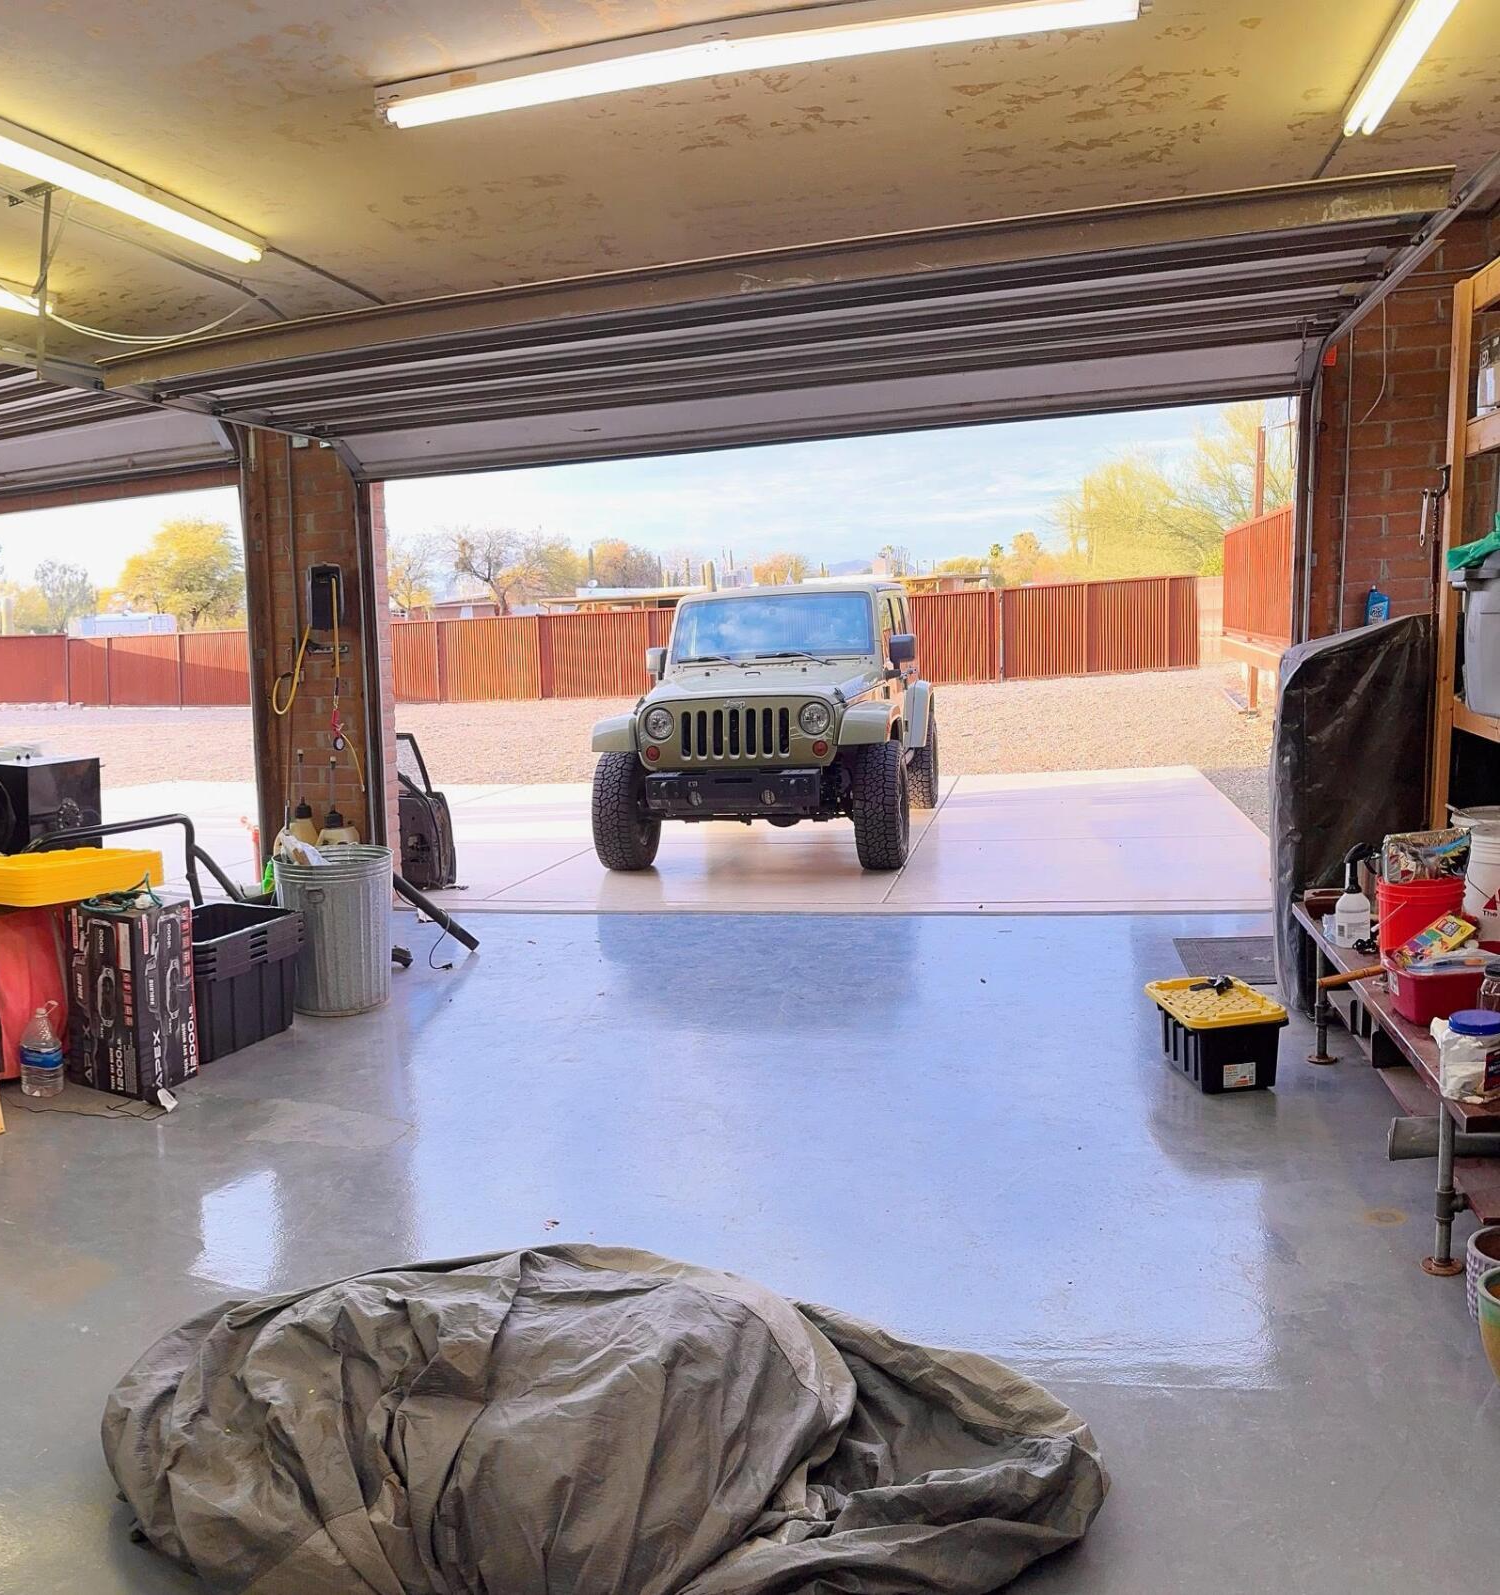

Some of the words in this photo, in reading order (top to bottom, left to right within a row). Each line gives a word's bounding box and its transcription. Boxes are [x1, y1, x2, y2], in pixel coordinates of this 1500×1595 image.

[723, 700, 746, 710] Jeep
[82, 1024, 93, 1083] APEX
[152, 1029, 164, 1088] APEX
